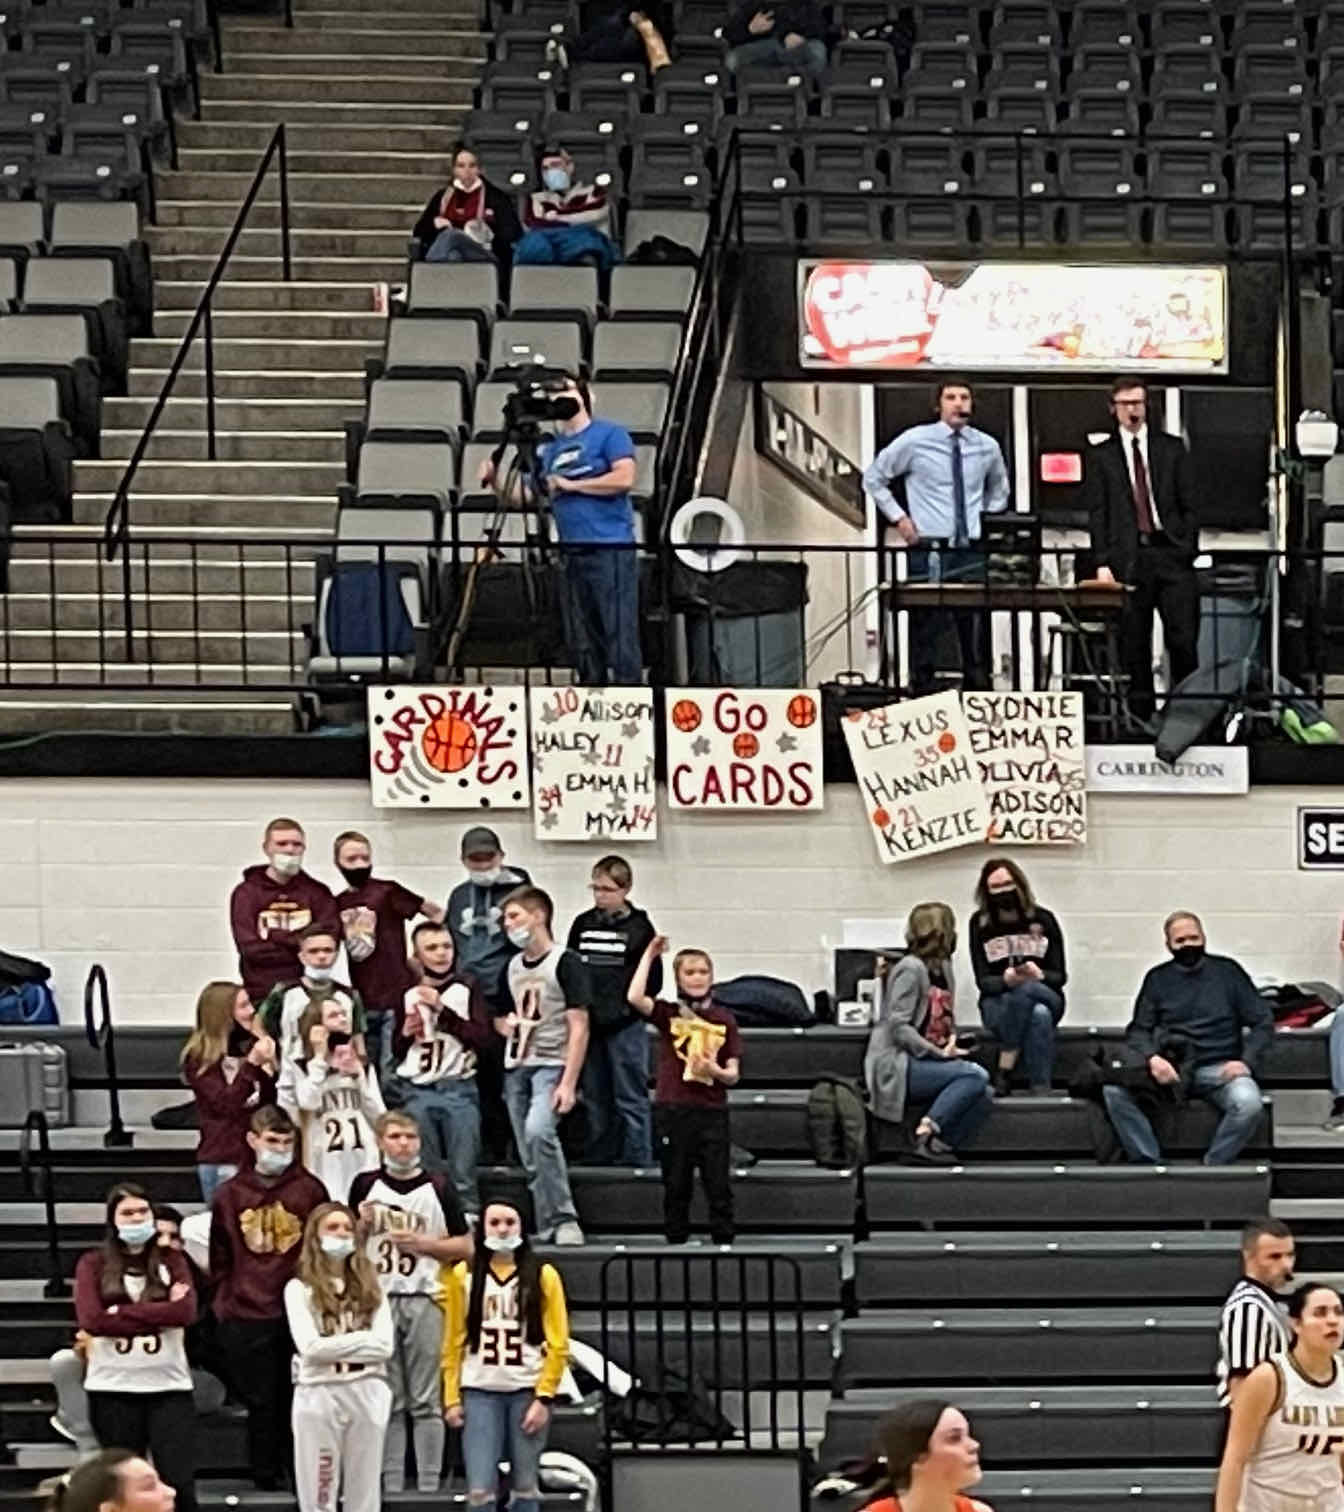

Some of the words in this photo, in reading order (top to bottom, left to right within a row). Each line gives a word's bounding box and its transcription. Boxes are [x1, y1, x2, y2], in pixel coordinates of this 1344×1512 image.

[553, 688, 578, 716] 10
[967, 696, 1076, 723] SYDNIE
[374, 690, 518, 785] CARDINALS
[535, 732, 600, 753] HALEY
[861, 709, 950, 750] LEXUS
[969, 726, 1048, 753] EMMA
[602, 744, 623, 767] 11
[914, 747, 941, 768] 35
[566, 773, 627, 793] EMMA
[862, 754, 972, 807] HANNAH
[1097, 762, 1226, 777] CARRINGTON
[672, 762, 813, 806] CARDS
[585, 811, 632, 834] MYA
[881, 808, 982, 856] KENZIE
[325, 1117, 365, 1153] 21
[482, 1328, 524, 1366] 35
